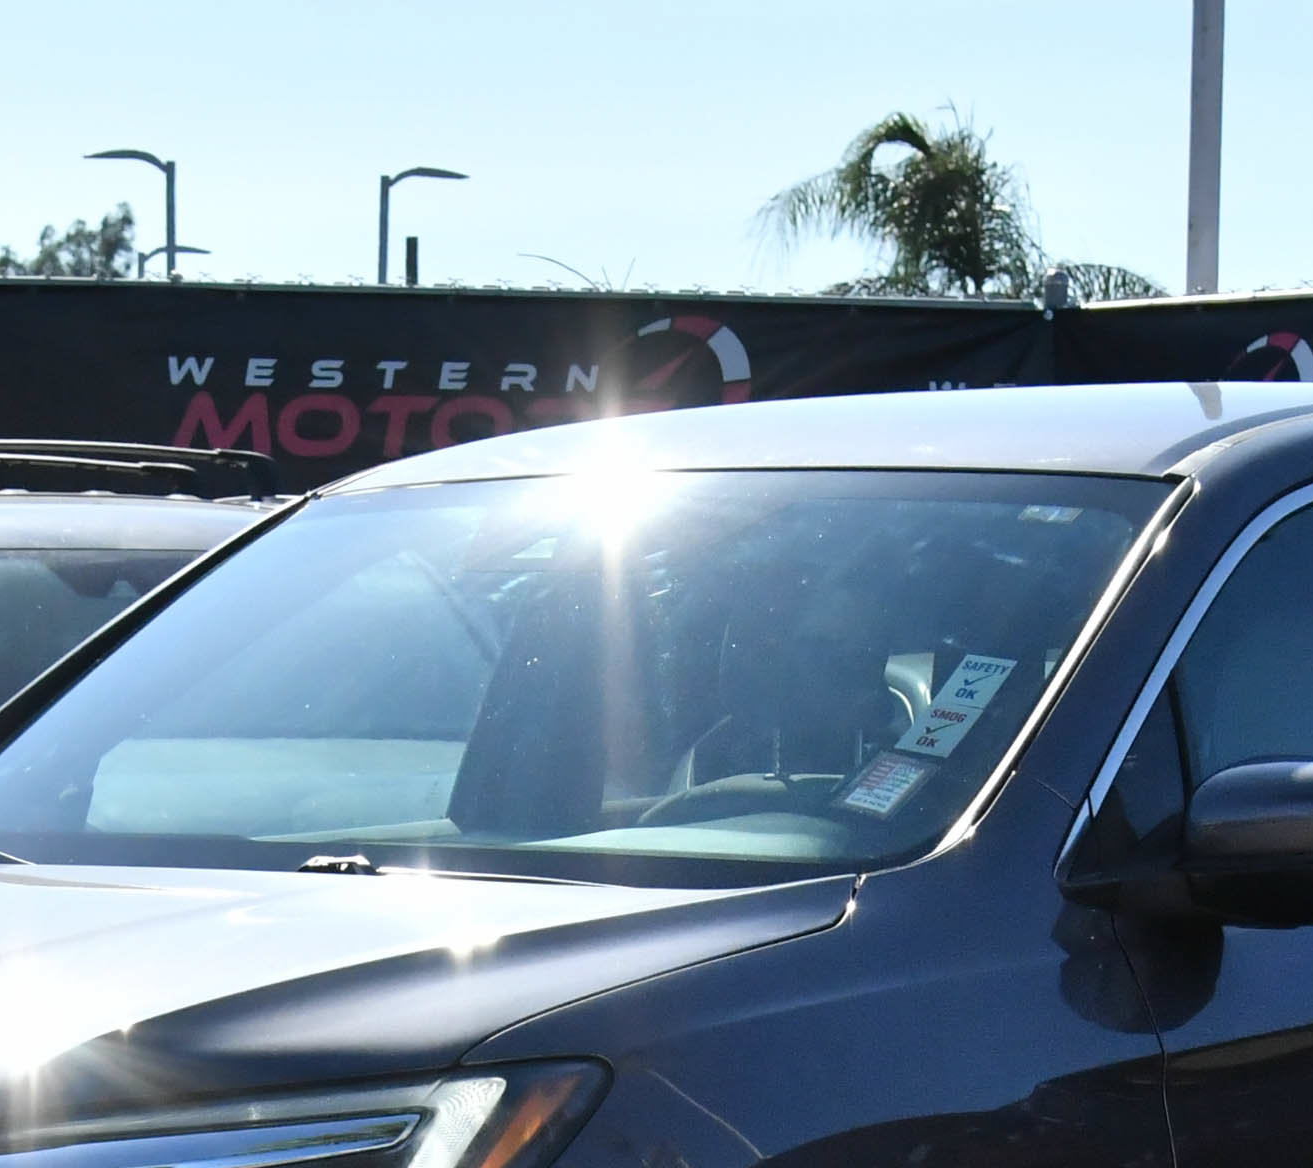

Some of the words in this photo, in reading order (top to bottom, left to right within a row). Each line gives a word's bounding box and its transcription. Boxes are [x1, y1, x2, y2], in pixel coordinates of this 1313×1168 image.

[167, 356, 599, 392] WESTERN
[170, 391, 677, 458] MOTO
[961, 659, 1010, 676] SAFETY
[955, 686, 978, 700] OK
[930, 708, 968, 724] SMOG
[916, 735, 940, 749] OK
